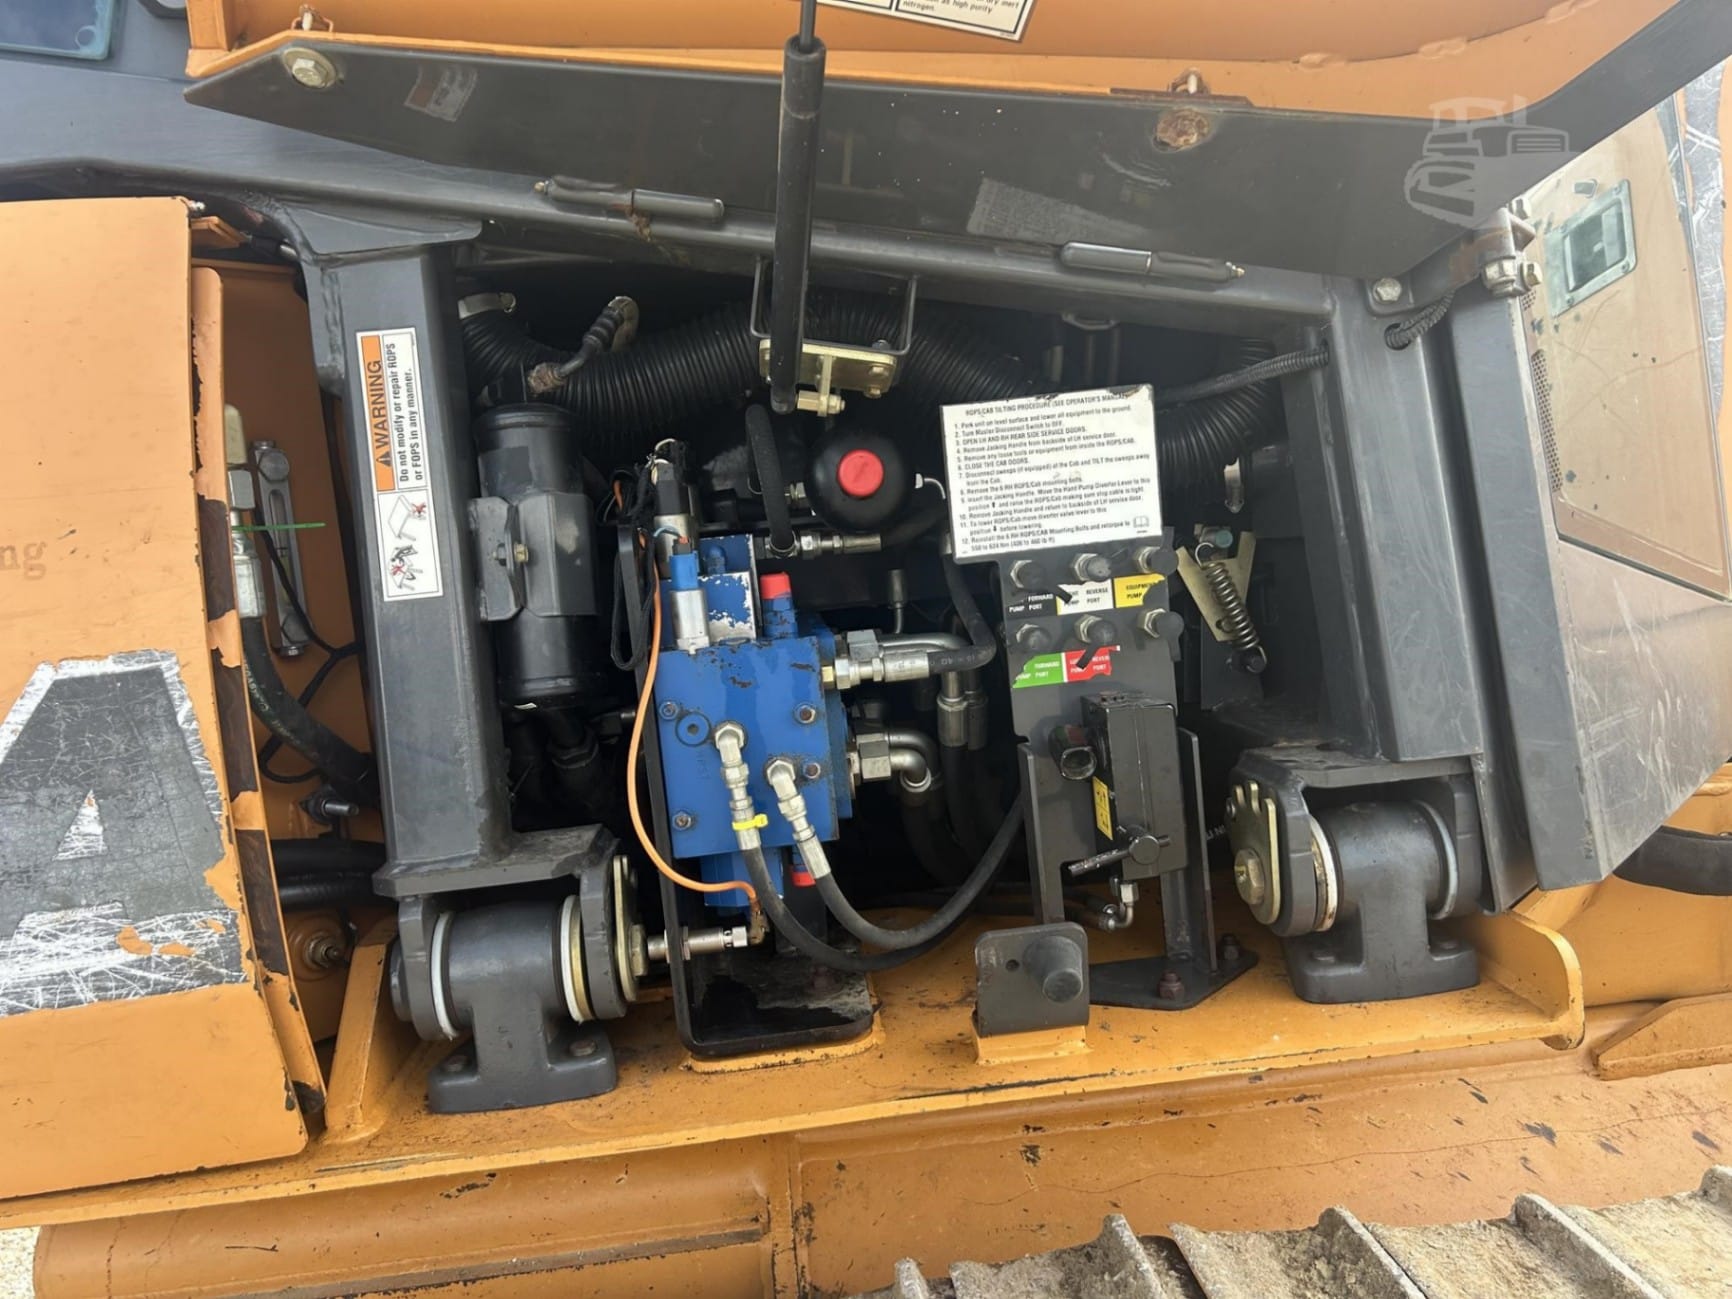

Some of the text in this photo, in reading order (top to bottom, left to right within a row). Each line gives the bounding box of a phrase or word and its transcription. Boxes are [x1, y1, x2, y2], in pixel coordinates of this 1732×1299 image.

[367, 360, 390, 449] WARNING
[386, 343, 409, 482] Do not modify or repair ROPS
[405, 368, 423, 481] or FOPS in any manner.
[1008, 603, 1043, 613] PUMP PORT
[1086, 587, 1108, 595] REVERSE
[1126, 592, 1143, 600] PUMP
